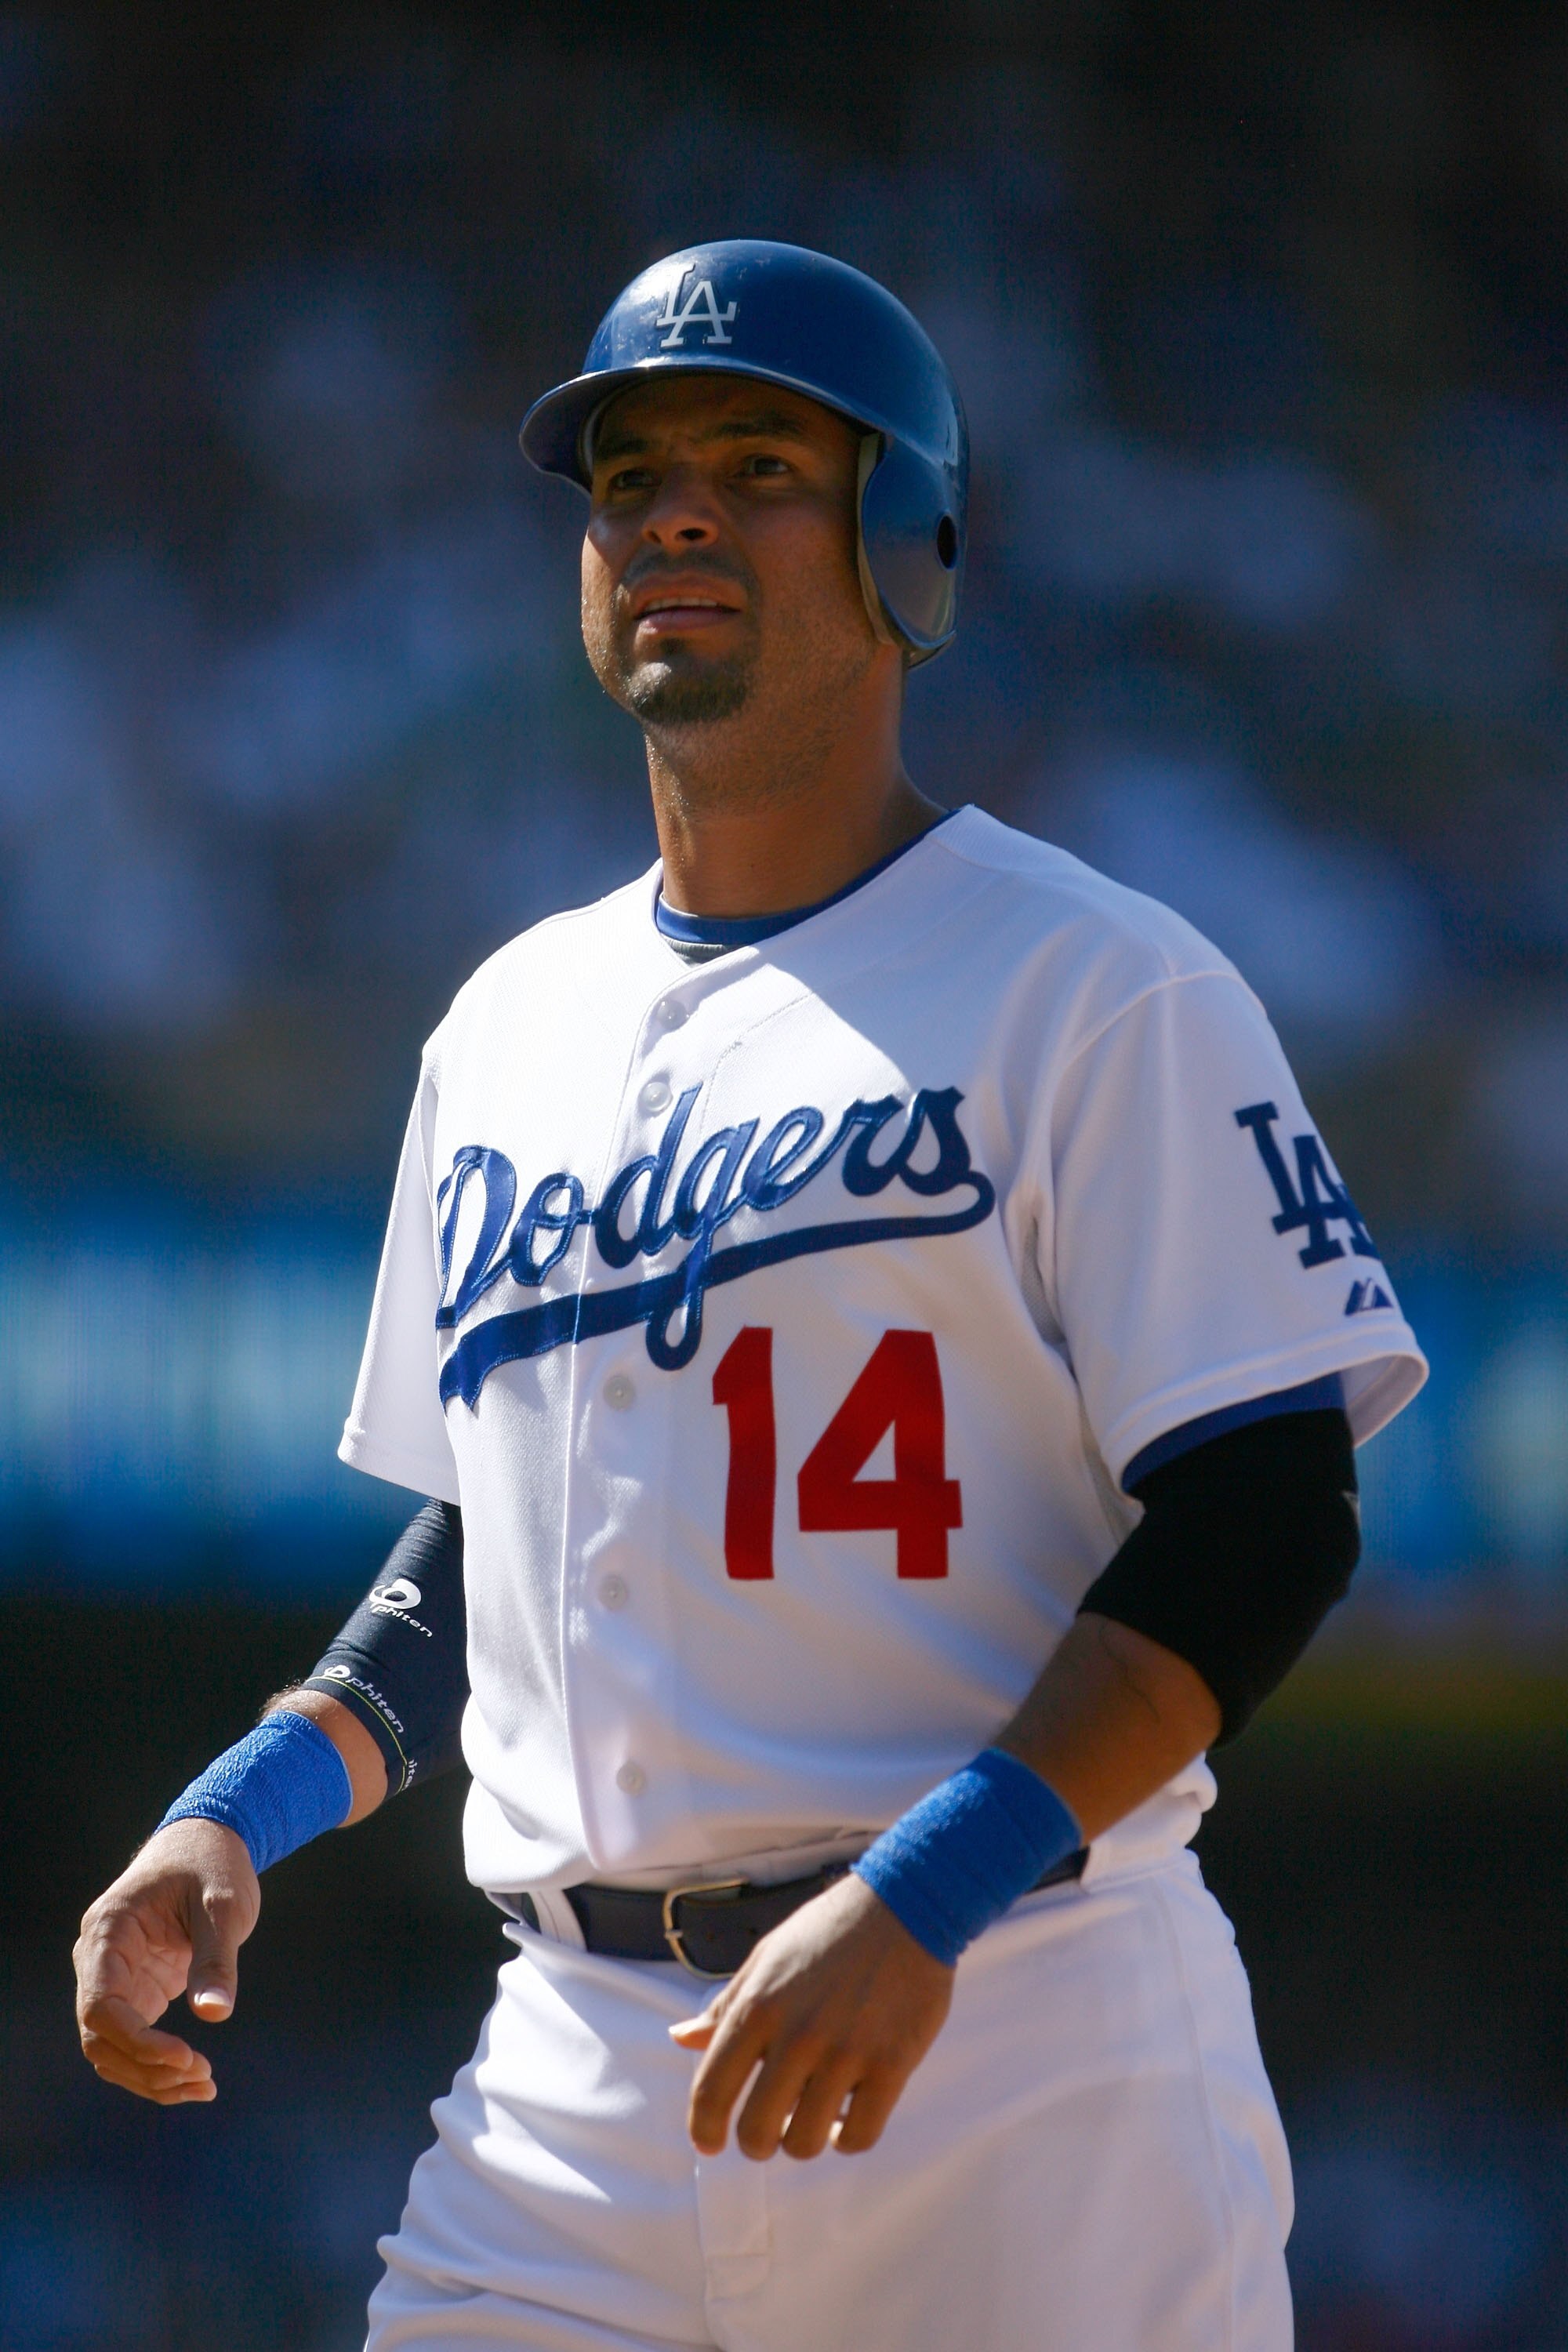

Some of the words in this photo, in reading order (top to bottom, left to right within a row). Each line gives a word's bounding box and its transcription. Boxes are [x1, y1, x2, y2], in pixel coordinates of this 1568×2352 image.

[656, 263, 738, 348] LA
[435, 1083, 995, 1371] Dodgers
[1233, 1101, 1382, 1270] LA
[712, 1325, 964, 1581] 14
[345, 1676, 405, 1733] phiten
